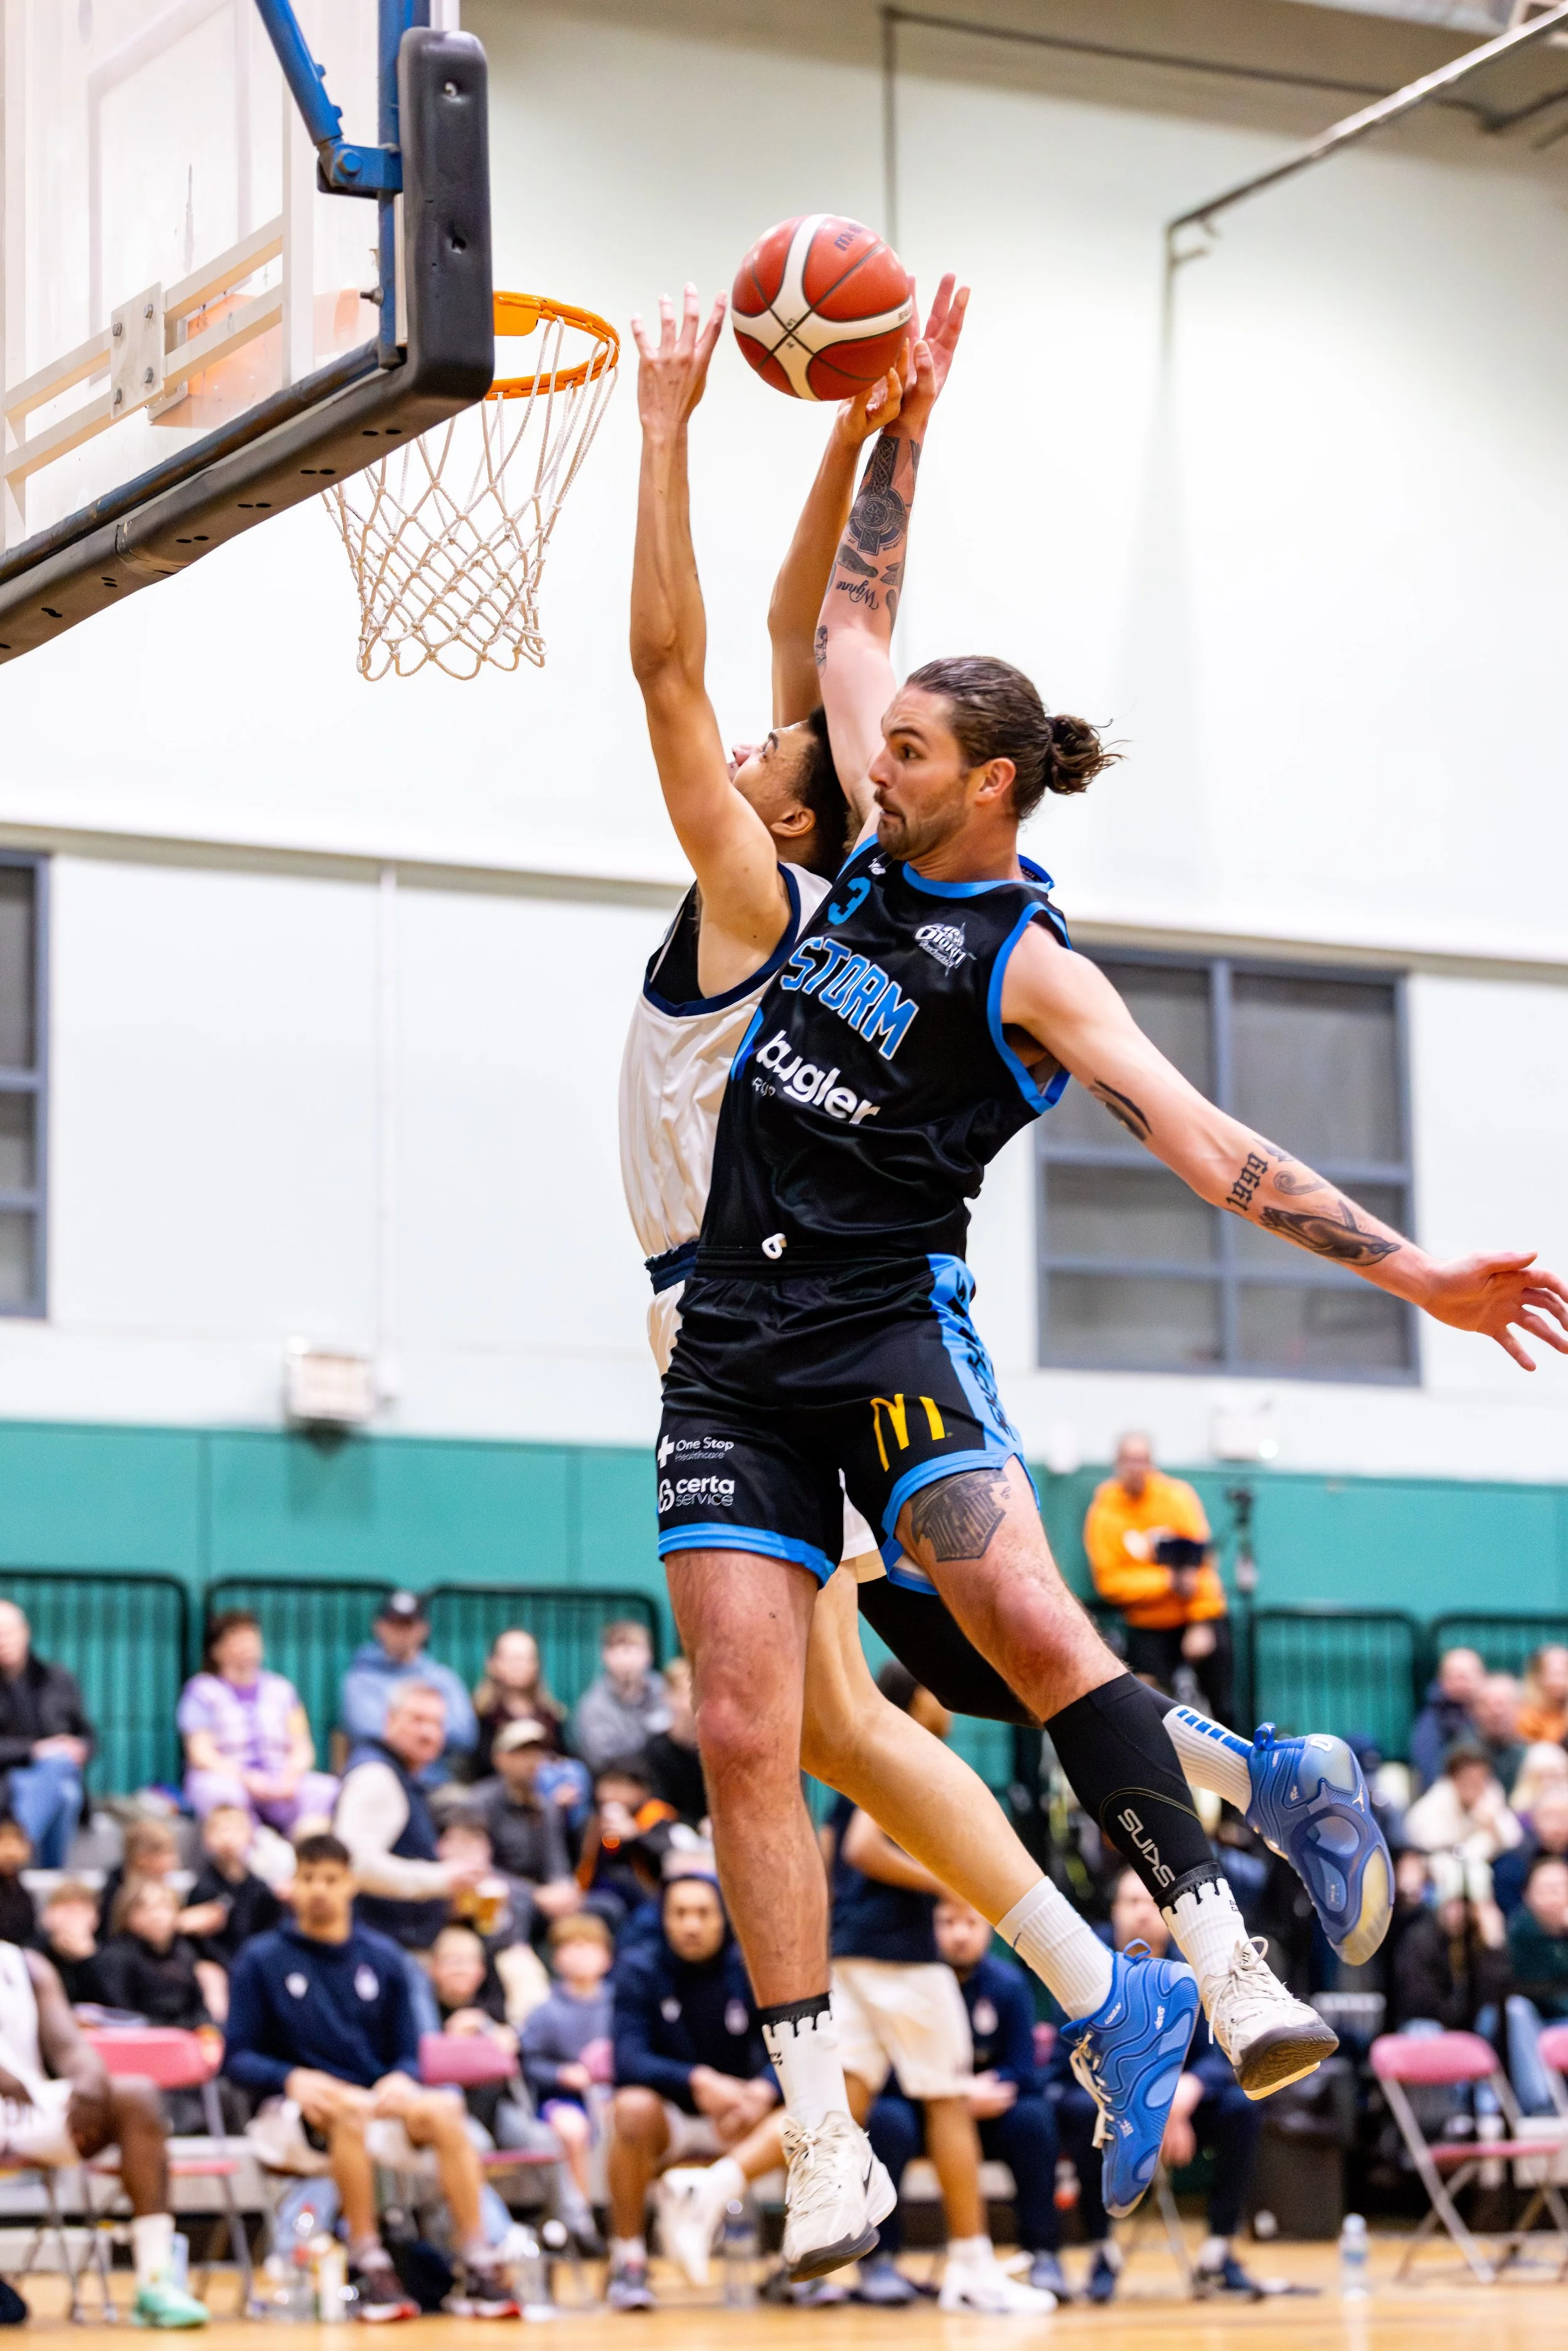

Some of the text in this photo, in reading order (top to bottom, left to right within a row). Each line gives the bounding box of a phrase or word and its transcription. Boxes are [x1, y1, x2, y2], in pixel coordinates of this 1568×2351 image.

[827, 876, 871, 926] 3
[780, 937, 919, 1061] STORM
[756, 1029, 881, 1125] bugler
[1225, 1152, 1269, 1211] 1999
[675, 1436, 734, 1452] One Stop
[675, 1475, 736, 1495] certa
[675, 1493, 734, 1507] service
